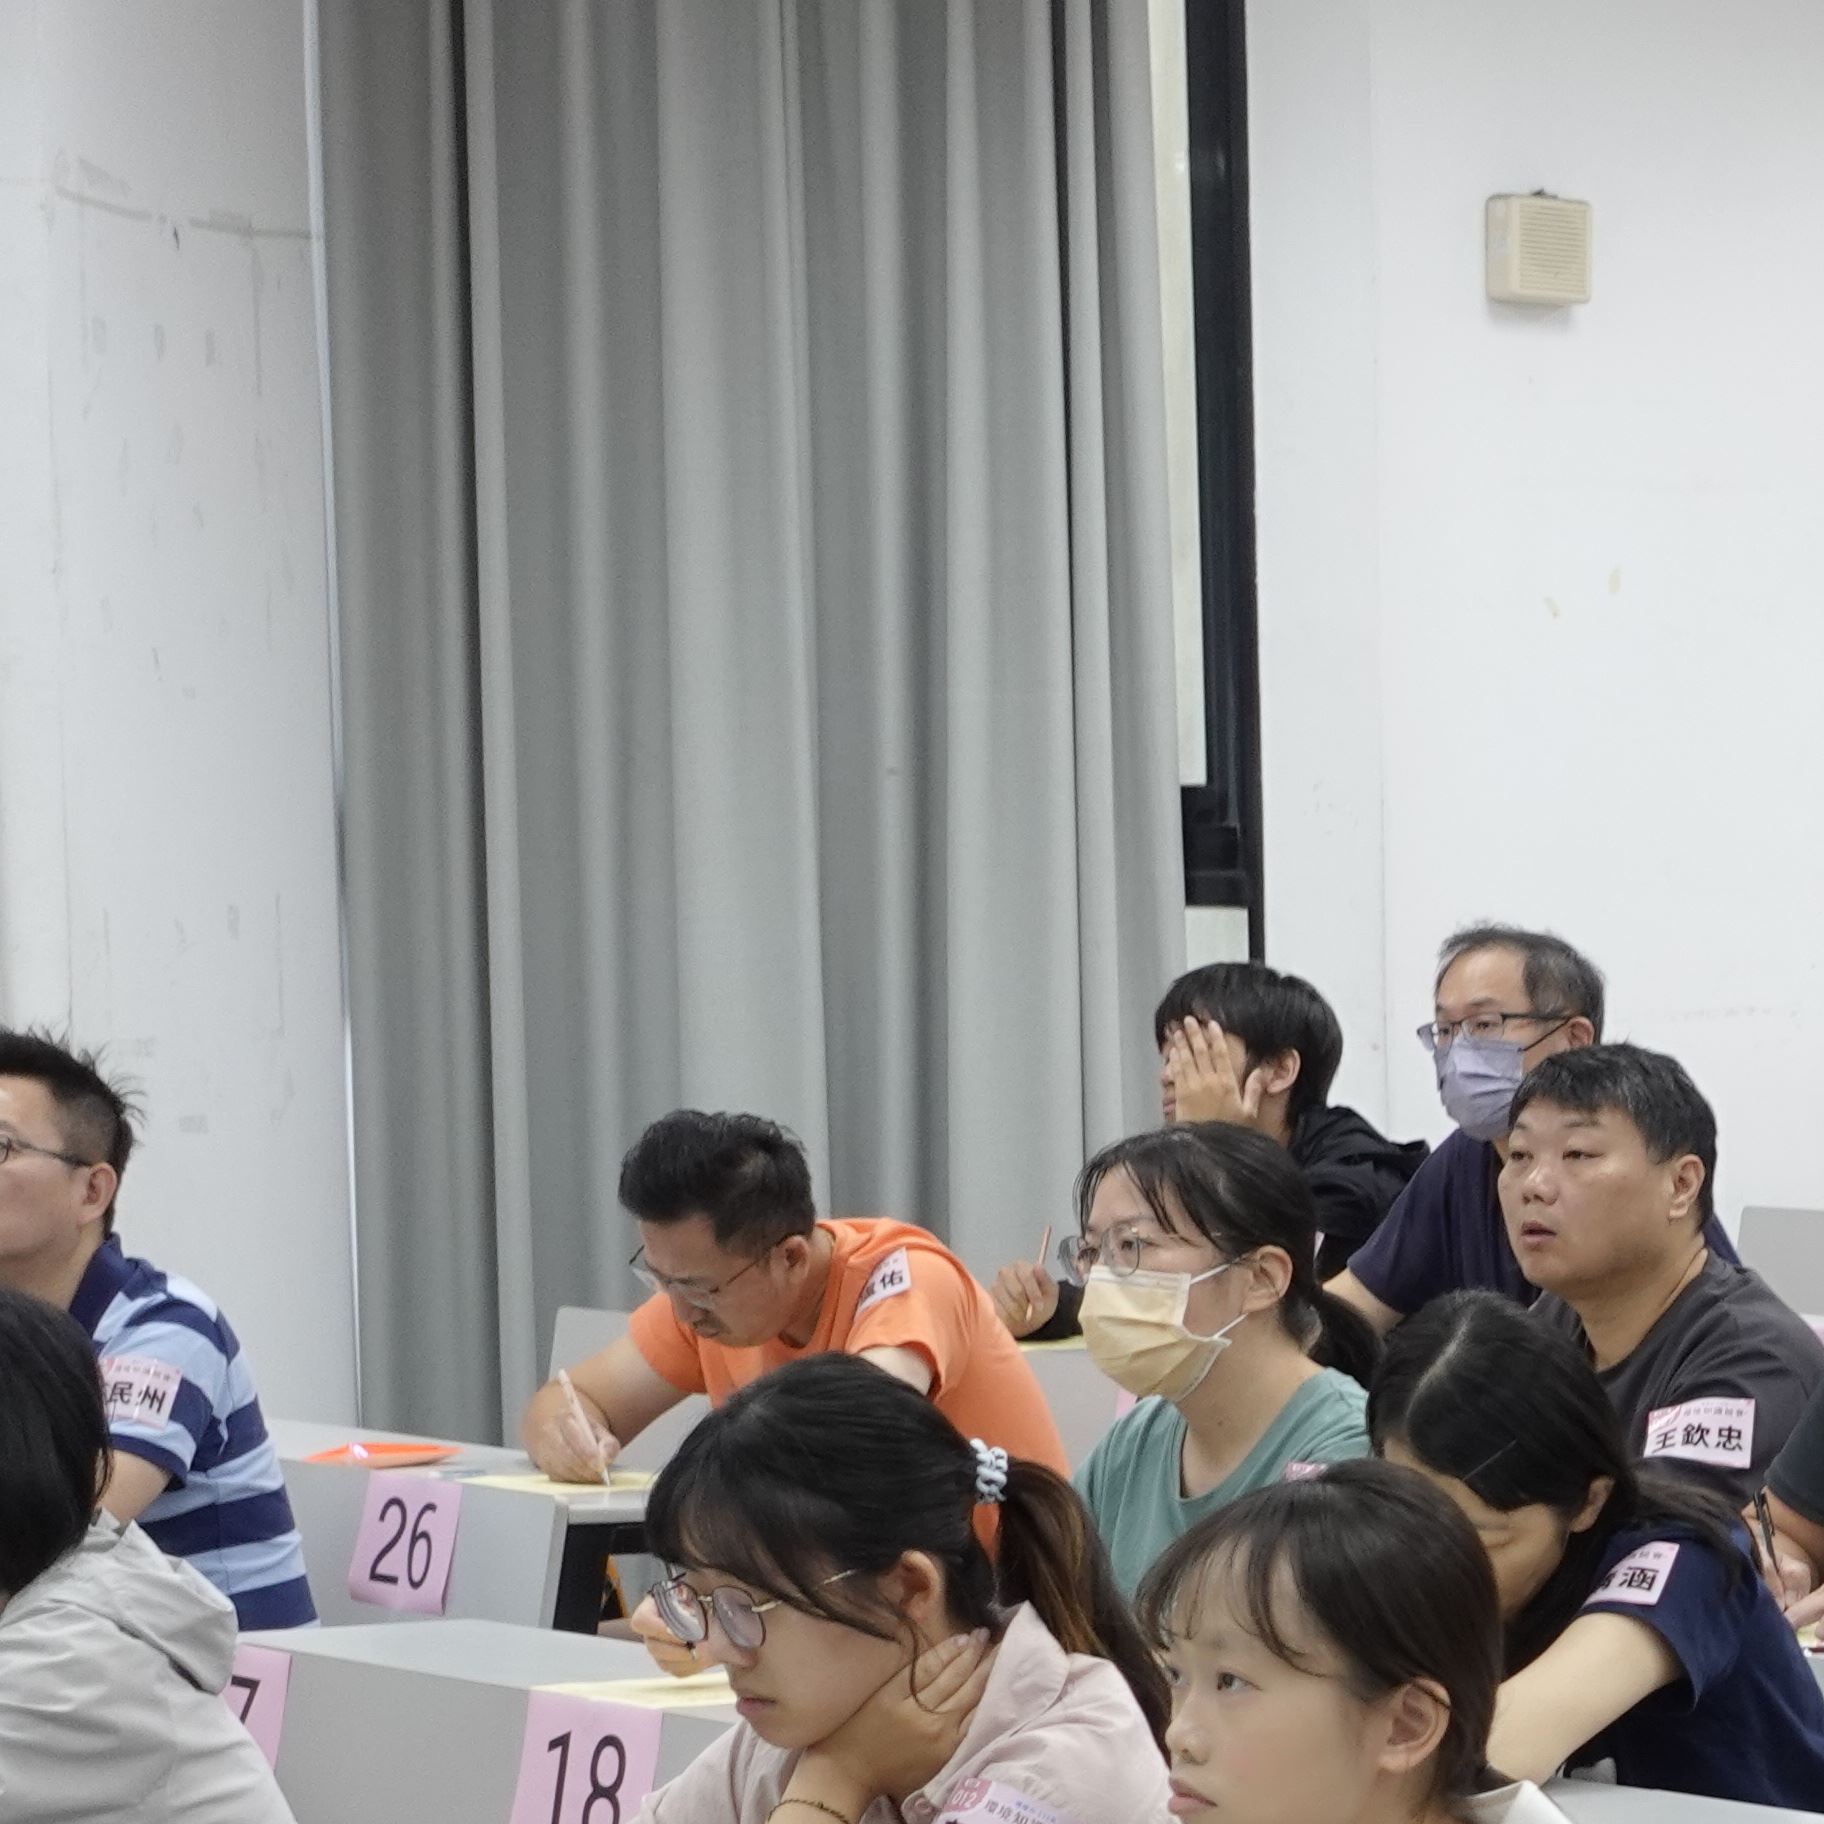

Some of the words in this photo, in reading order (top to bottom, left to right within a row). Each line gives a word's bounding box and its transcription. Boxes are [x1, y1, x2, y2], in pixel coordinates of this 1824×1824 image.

[104, 1381, 167, 1414] 民州
[1652, 1423, 1743, 1454] 王欽忠
[368, 1497, 437, 1590] 26
[952, 1789, 978, 1809] 012
